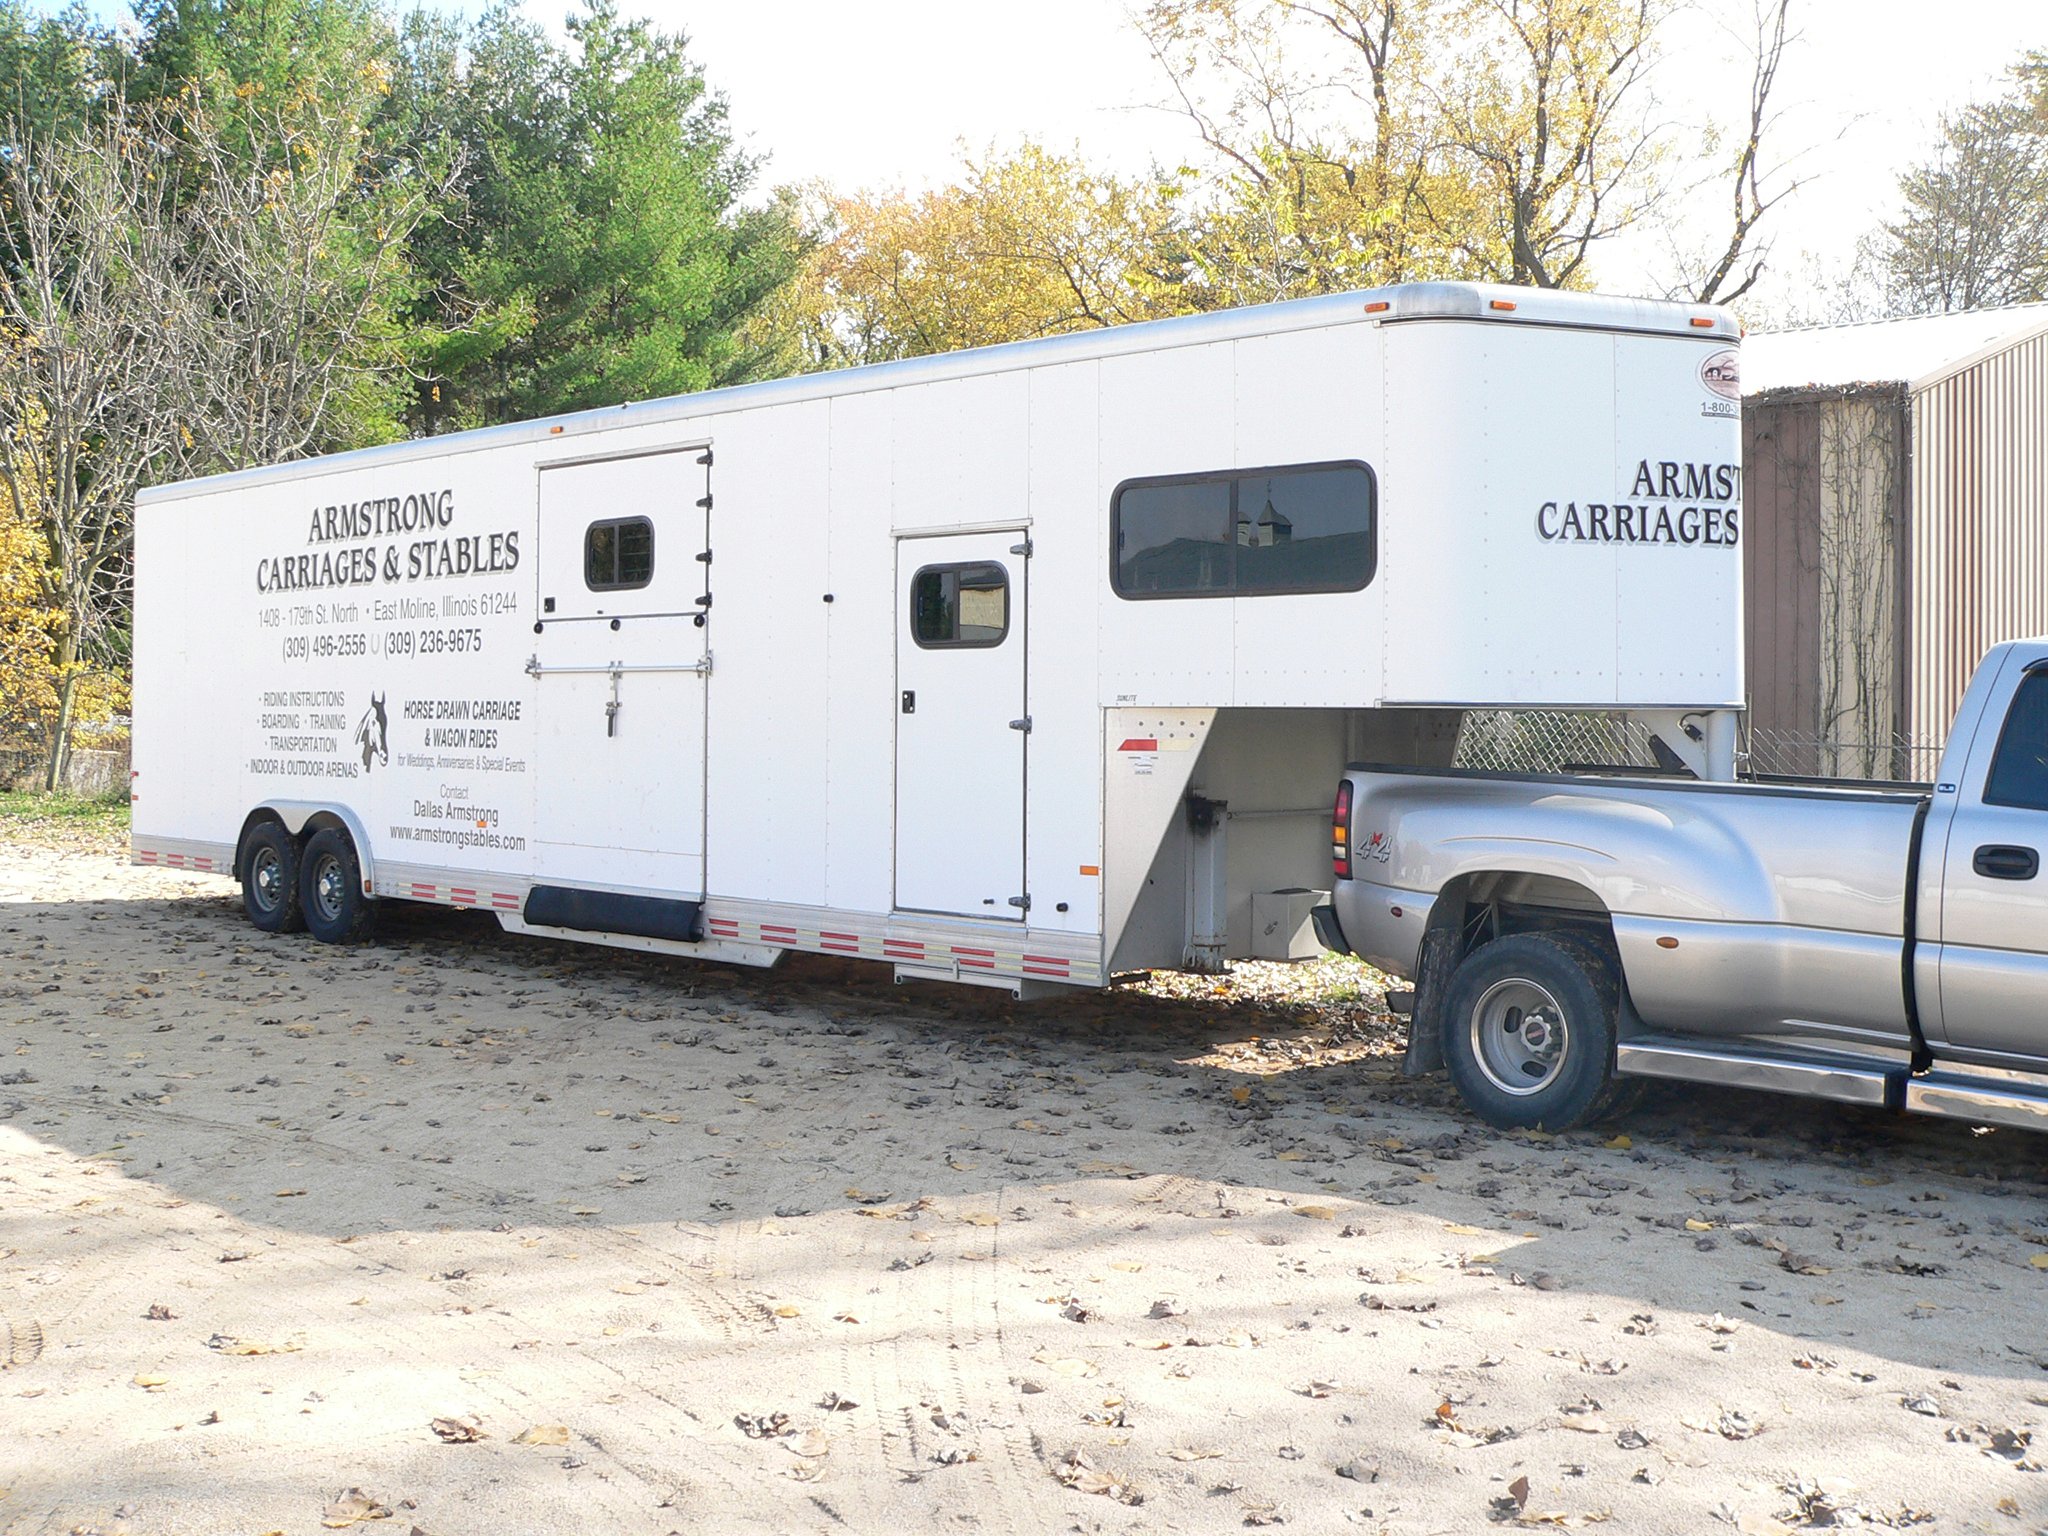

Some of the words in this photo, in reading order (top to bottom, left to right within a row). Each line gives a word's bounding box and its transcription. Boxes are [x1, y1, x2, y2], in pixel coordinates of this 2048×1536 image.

[308, 489, 454, 544] ARMSTRONG
[1536, 501, 1739, 547] CARRIAGES
[257, 547, 377, 593] CARRIAGES
[383, 545, 401, 583] &
[408, 530, 520, 582] STABLES
[259, 607, 280, 627] 1408
[289, 605, 313, 626] 179th
[316, 603, 329, 625] St.
[332, 602, 359, 623] North
[374, 600, 397, 621] East
[400, 597, 439, 622] Moline,
[442, 594, 478, 617] Illinois
[480, 591, 517, 615] 61244
[282, 635, 310, 663] (309)
[313, 633, 366, 657] 496-2556
[384, 630, 416, 660] (309)
[420, 628, 482, 653] 236-9675
[263, 692, 288, 707] RIDING
[289, 691, 345, 707] INSTRUCTIONS
[403, 700, 434, 719] HORSE
[436, 700, 470, 720] DRAWN
[472, 700, 521, 721] CARRIAGE
[262, 714, 300, 729] BOARDING
[310, 714, 346, 730] TRAINING
[269, 735, 337, 753] TRANSPORTATION
[424, 727, 431, 747] &
[433, 728, 467, 748] WAGON
[468, 729, 498, 749] RIDES
[250, 758, 279, 774] INDOOR
[280, 760, 286, 775] &
[287, 759, 325, 777] OUTDOOR
[326, 761, 359, 778] ARENAS
[397, 752, 406, 766] for
[481, 755, 505, 774] Special
[505, 757, 526, 773] Events
[440, 783, 469, 800] Contact
[414, 799, 443, 819] Dallas
[446, 802, 499, 828] Armstrong
[390, 825, 526, 851] www.armstrongstables.com
